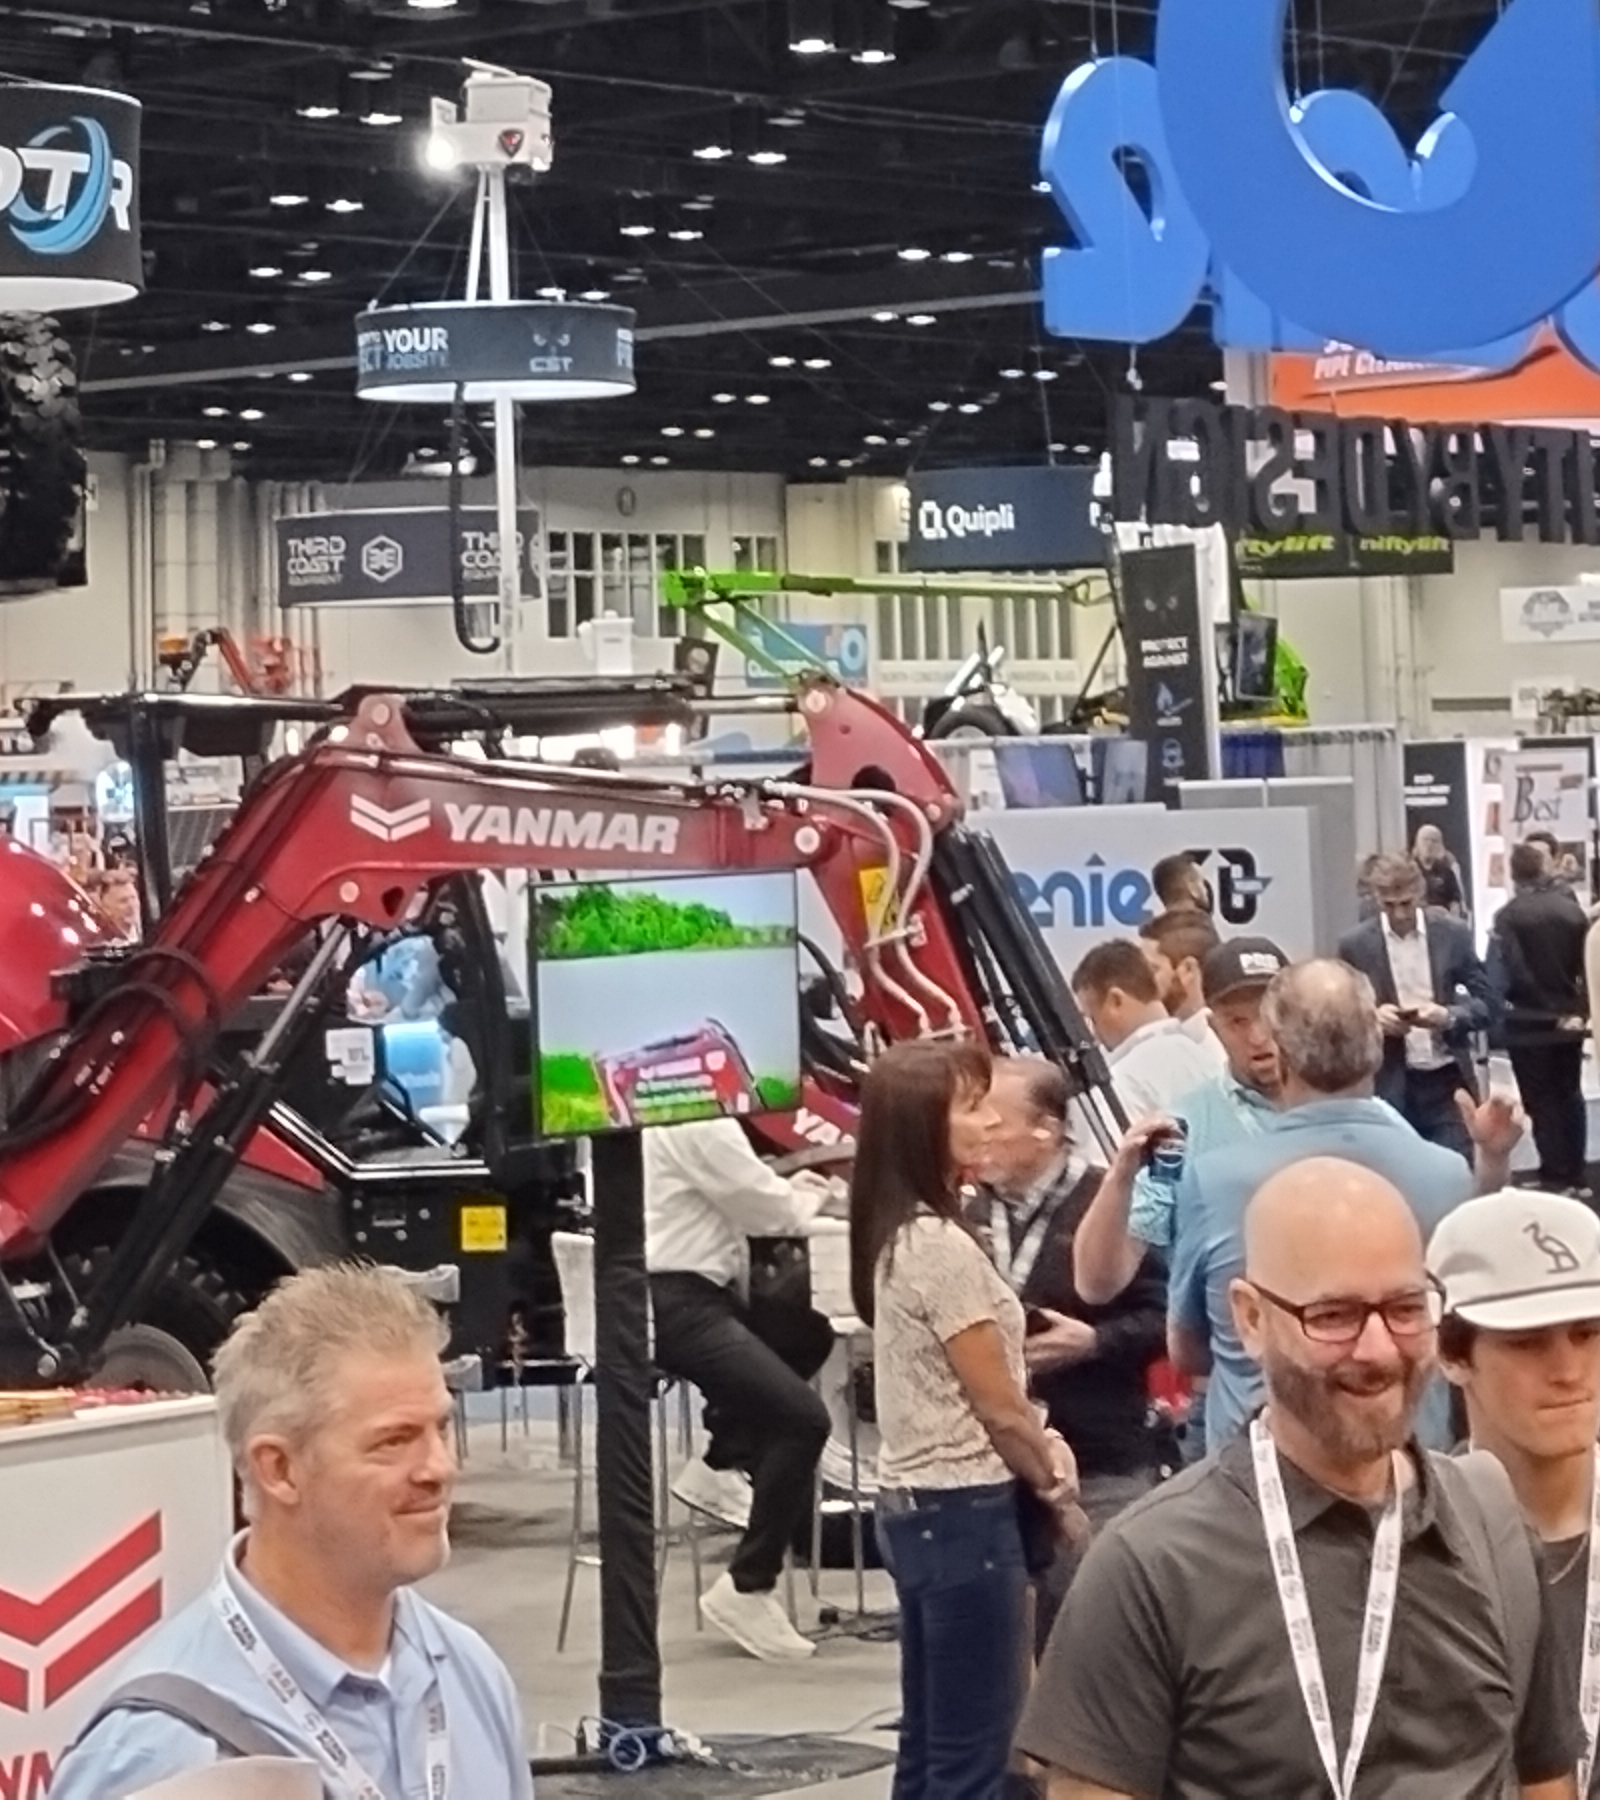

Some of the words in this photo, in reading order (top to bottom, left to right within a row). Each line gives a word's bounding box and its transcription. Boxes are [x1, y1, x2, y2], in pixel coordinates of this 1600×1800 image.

[384, 327, 449, 352] YOUR
[946, 503, 1015, 540] Quipli
[287, 536, 346, 556] THIRD
[1360, 536, 1451, 555] niftylift
[287, 556, 344, 574] COAST
[444, 802, 680, 856] YANMAR
[1011, 850, 1156, 927] enie
